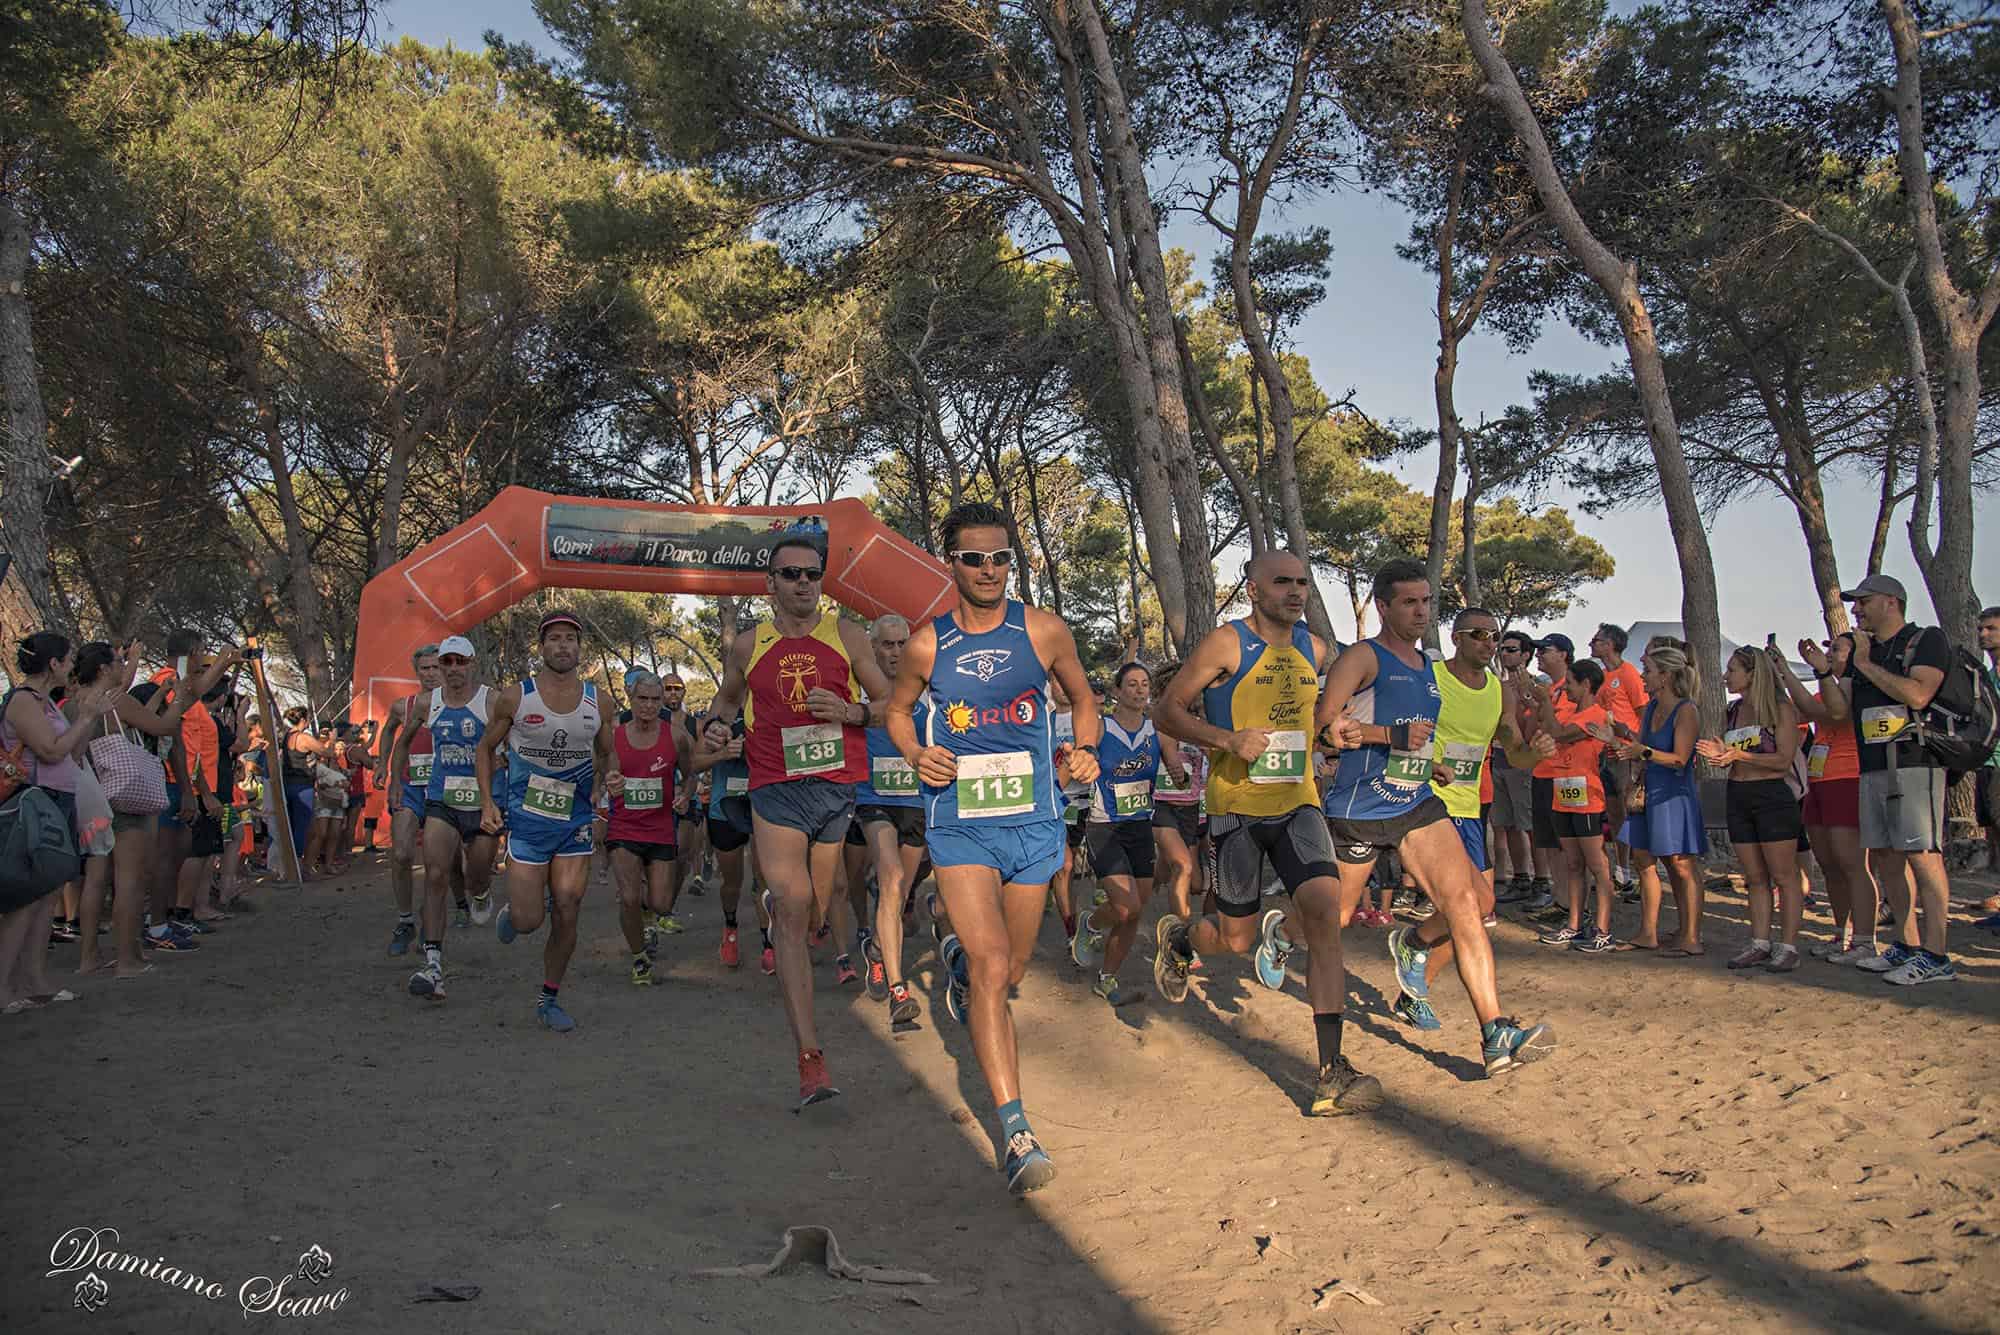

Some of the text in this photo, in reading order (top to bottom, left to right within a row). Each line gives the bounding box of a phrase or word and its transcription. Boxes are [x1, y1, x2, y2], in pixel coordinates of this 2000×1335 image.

[553, 535, 593, 556] Corri
[645, 541, 659, 562] il
[661, 543, 708, 563] Parco
[712, 545, 752, 566] della
[1879, 720, 1889, 732] 5
[795, 741, 837, 762] 138
[1266, 752, 1293, 770] 81
[1399, 758, 1427, 776] 127
[1455, 760, 1475, 775] 53
[416, 766, 433, 777] 65
[881, 771, 914, 785] 114
[455, 790, 476, 802] 99
[630, 790, 657, 802] 109
[970, 776, 1024, 801] 113
[535, 791, 568, 809] 133
[1125, 794, 1148, 809] 120
